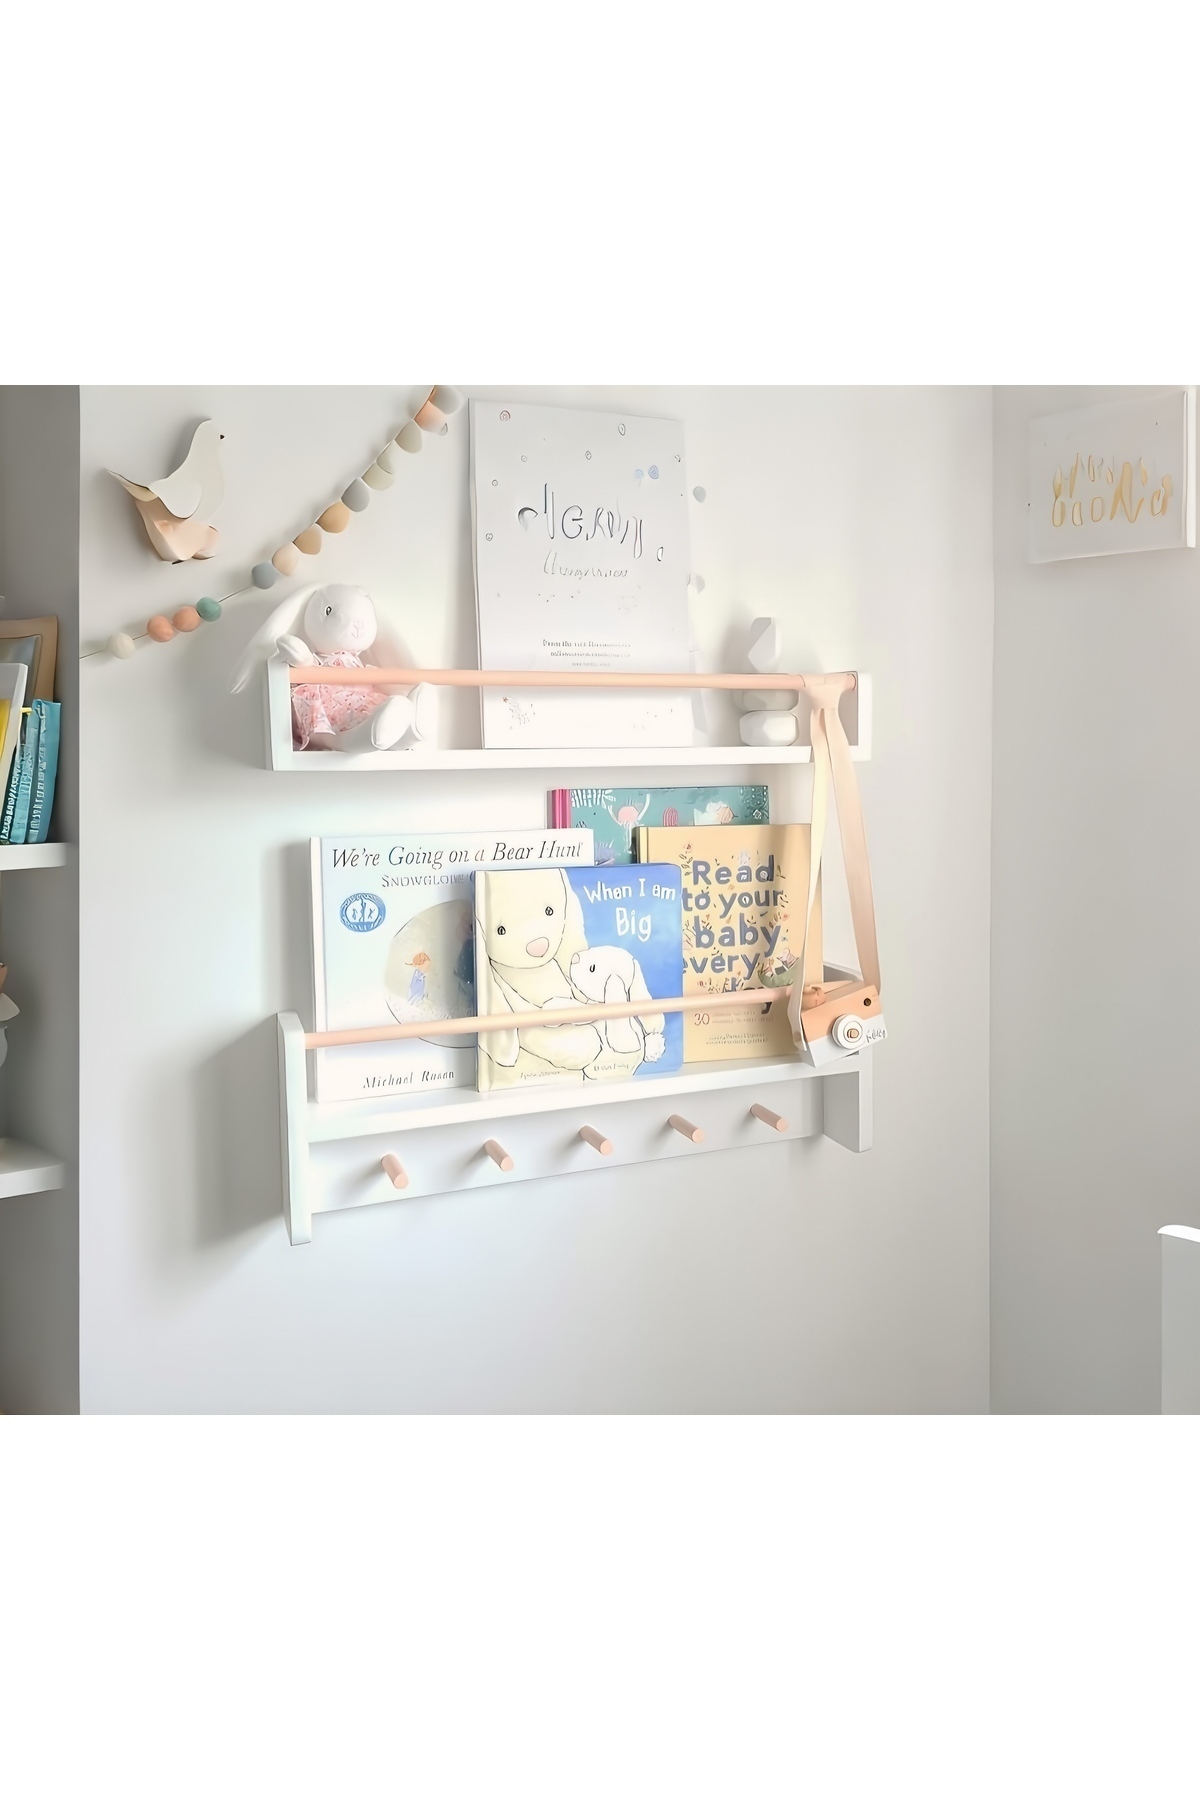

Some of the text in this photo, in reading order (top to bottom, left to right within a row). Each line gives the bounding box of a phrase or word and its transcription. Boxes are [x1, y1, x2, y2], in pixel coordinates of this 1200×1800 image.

[332, 839, 583, 870] We're Going on a Bear Hunt
[692, 854, 775, 886] Read
[583, 878, 676, 904] When I am
[682, 887, 784, 919] to your
[615, 907, 652, 942] Big
[693, 912, 781, 958] baby
[694, 1012, 711, 1027] 30
